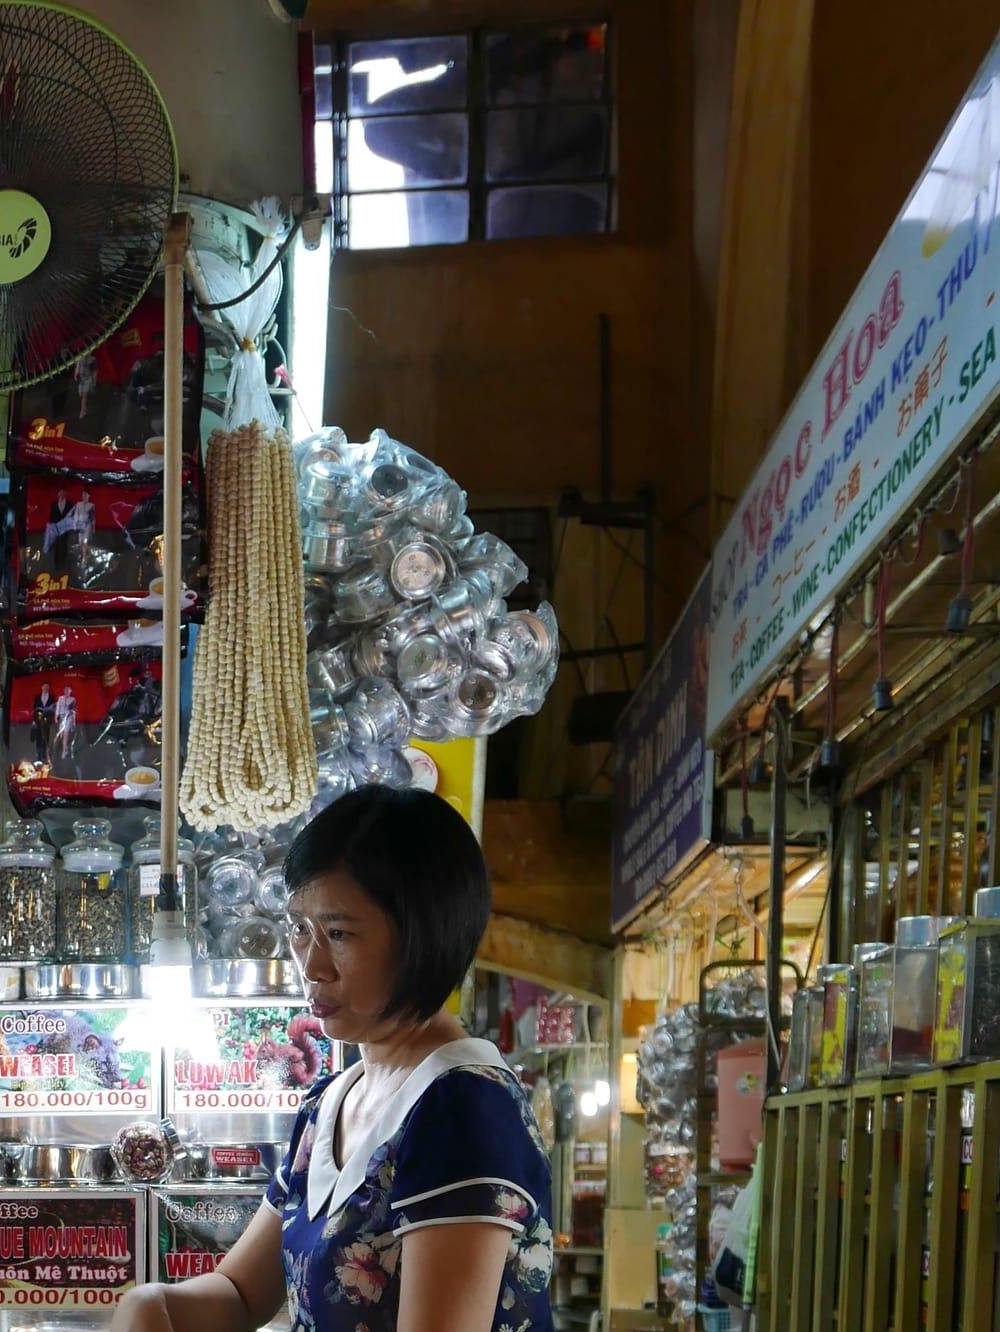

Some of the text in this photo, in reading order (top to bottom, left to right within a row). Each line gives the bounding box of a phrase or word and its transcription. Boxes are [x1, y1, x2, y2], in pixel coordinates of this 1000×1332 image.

[821, 270, 904, 443] Hoa
[792, 563, 821, 617] WINE
[959, 325, 998, 404] SEA
[0, 1014, 66, 1035] Coffee
[175, 1058, 259, 1085] LUWAK
[1, 1091, 147, 1110] 180.000/100g
[216, 1155, 256, 1163] WEASEL
[165, 1203, 237, 1223] Coffee
[29, 1225, 128, 1258] MOUNTAIN
[34, 1261, 62, 1281] Mê
[65, 1264, 128, 1285] Thuột
